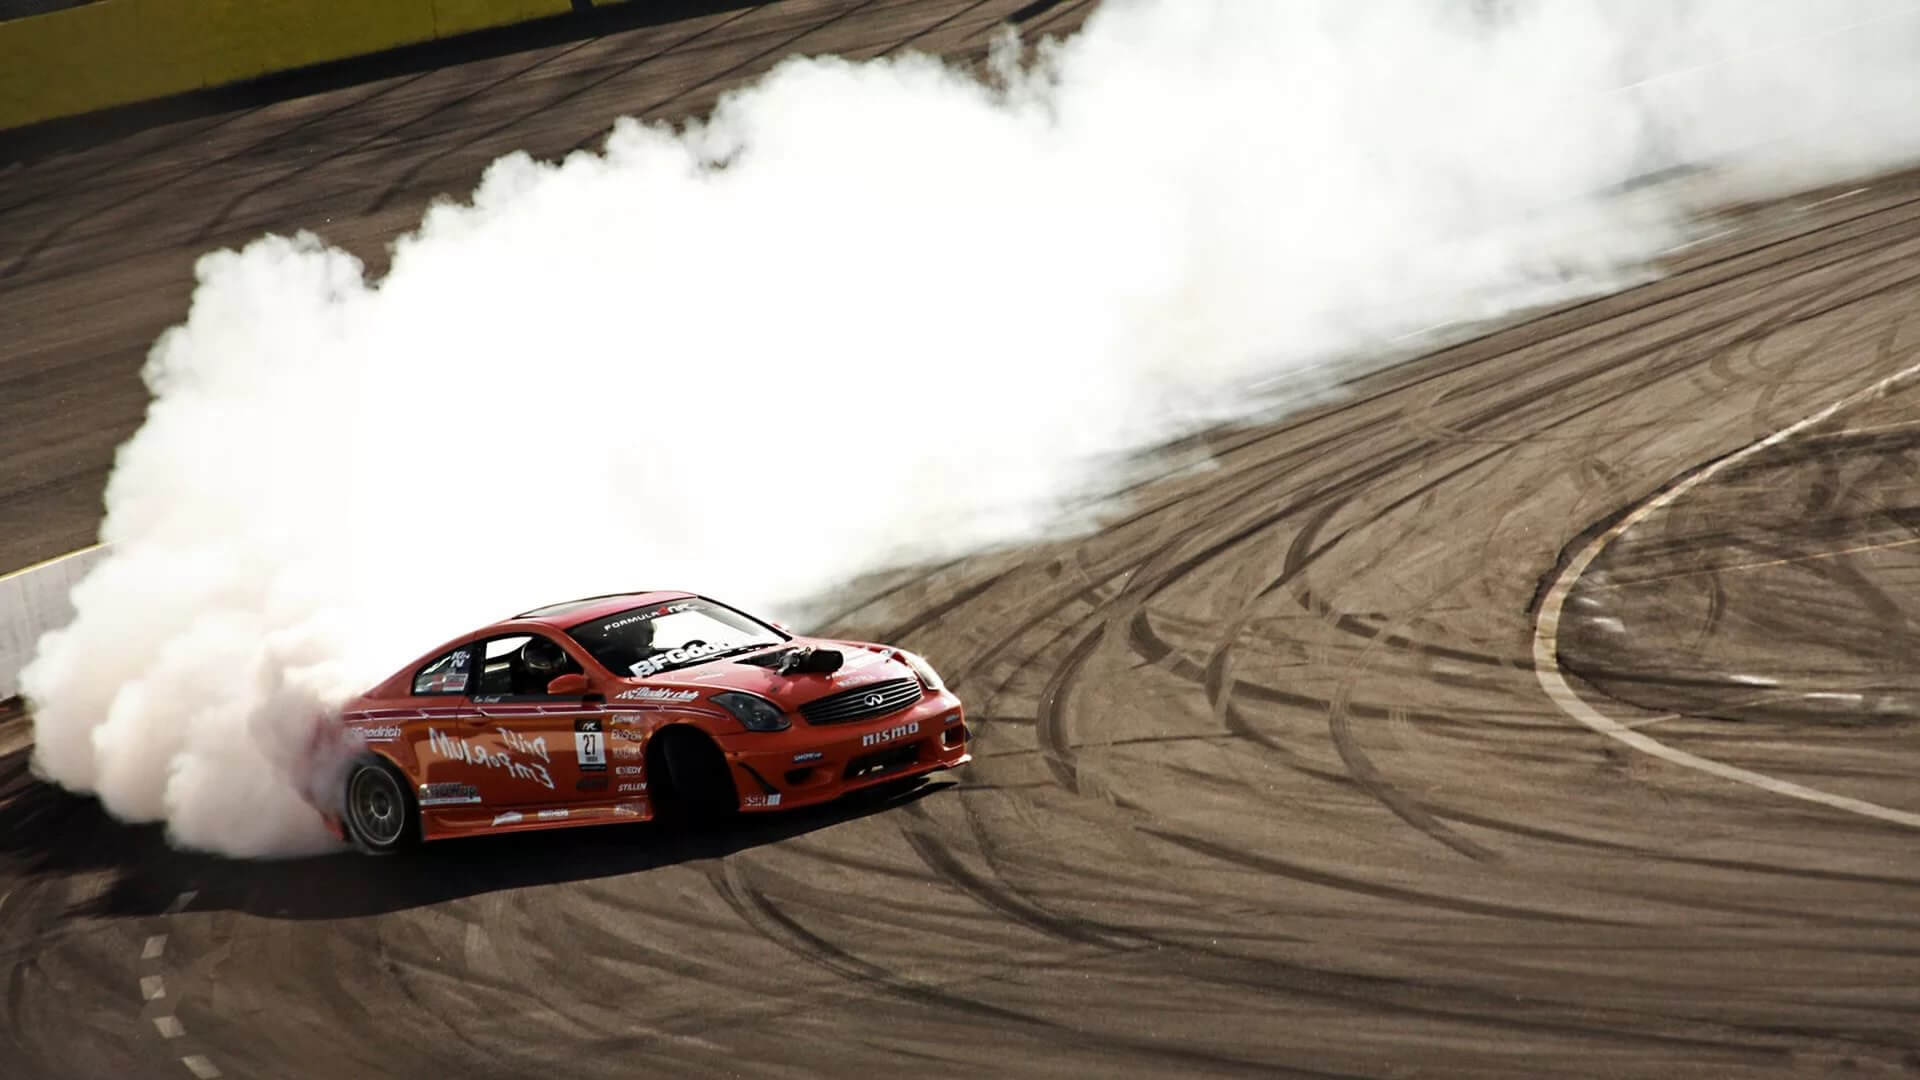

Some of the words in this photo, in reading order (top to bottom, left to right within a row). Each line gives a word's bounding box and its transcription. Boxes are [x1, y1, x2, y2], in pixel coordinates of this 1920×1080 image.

[603, 610, 661, 631] FORMULA
[583, 733, 596, 755] 27
[862, 721, 919, 747] nismo
